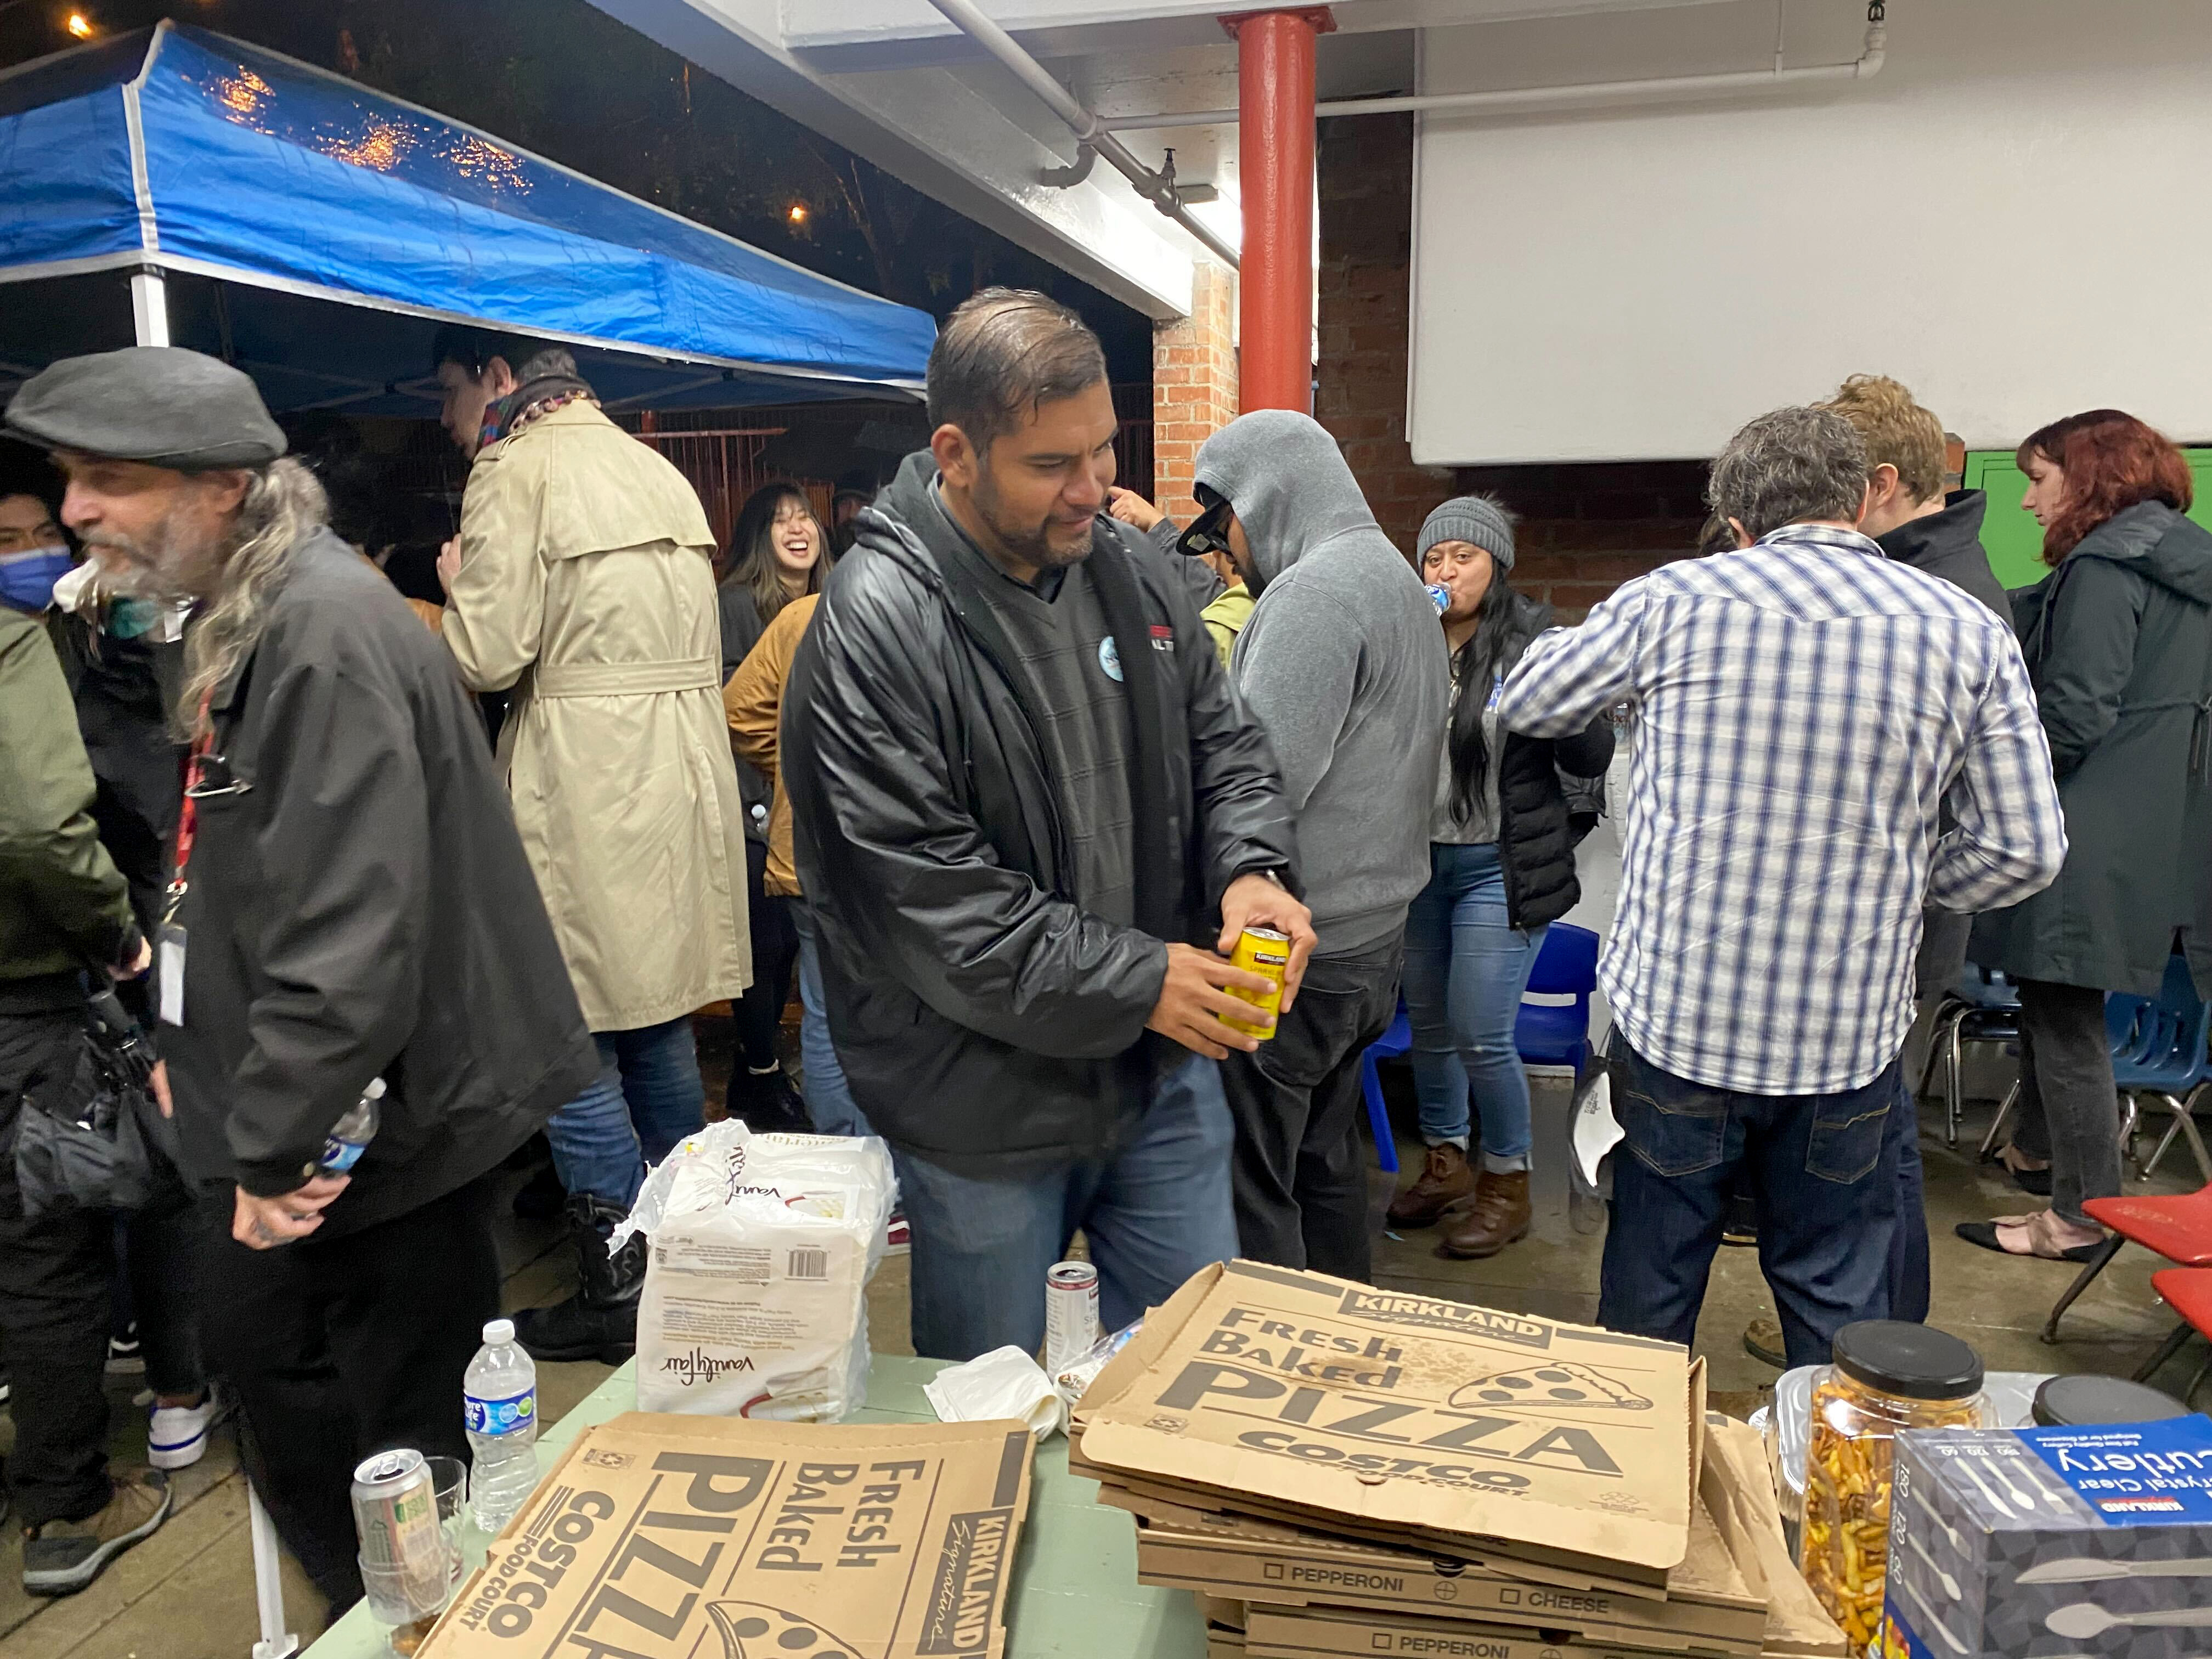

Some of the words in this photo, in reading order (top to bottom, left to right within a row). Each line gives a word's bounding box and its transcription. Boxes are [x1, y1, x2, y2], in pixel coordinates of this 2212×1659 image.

[1355, 1294, 1543, 1337] KIRKLAND
[1154, 1361, 1623, 1474] PIZZA
[1238, 1431, 1532, 1489] COSTCO
[1427, 1477, 1531, 1497] COURT
[1899, 1463, 1910, 1498] 180
[2079, 1479, 2142, 1492] Clear
[2145, 1475, 2212, 1492] rystal
[2101, 1502, 2185, 1513] KIRKLAND
[1896, 1511, 1907, 1545] 120
[487, 1491, 615, 1638] COSTCO
[499, 1534, 539, 1578] FOOD
[928, 1520, 971, 1651] Signature
[953, 1516, 1007, 1648] KIRKLAND
[1291, 1566, 1404, 1592] PEPPERONI
[459, 1577, 507, 1632] COURT
[1528, 1591, 1610, 1614] CHEESE
[1400, 1636, 1510, 1658] PEPPERONI
